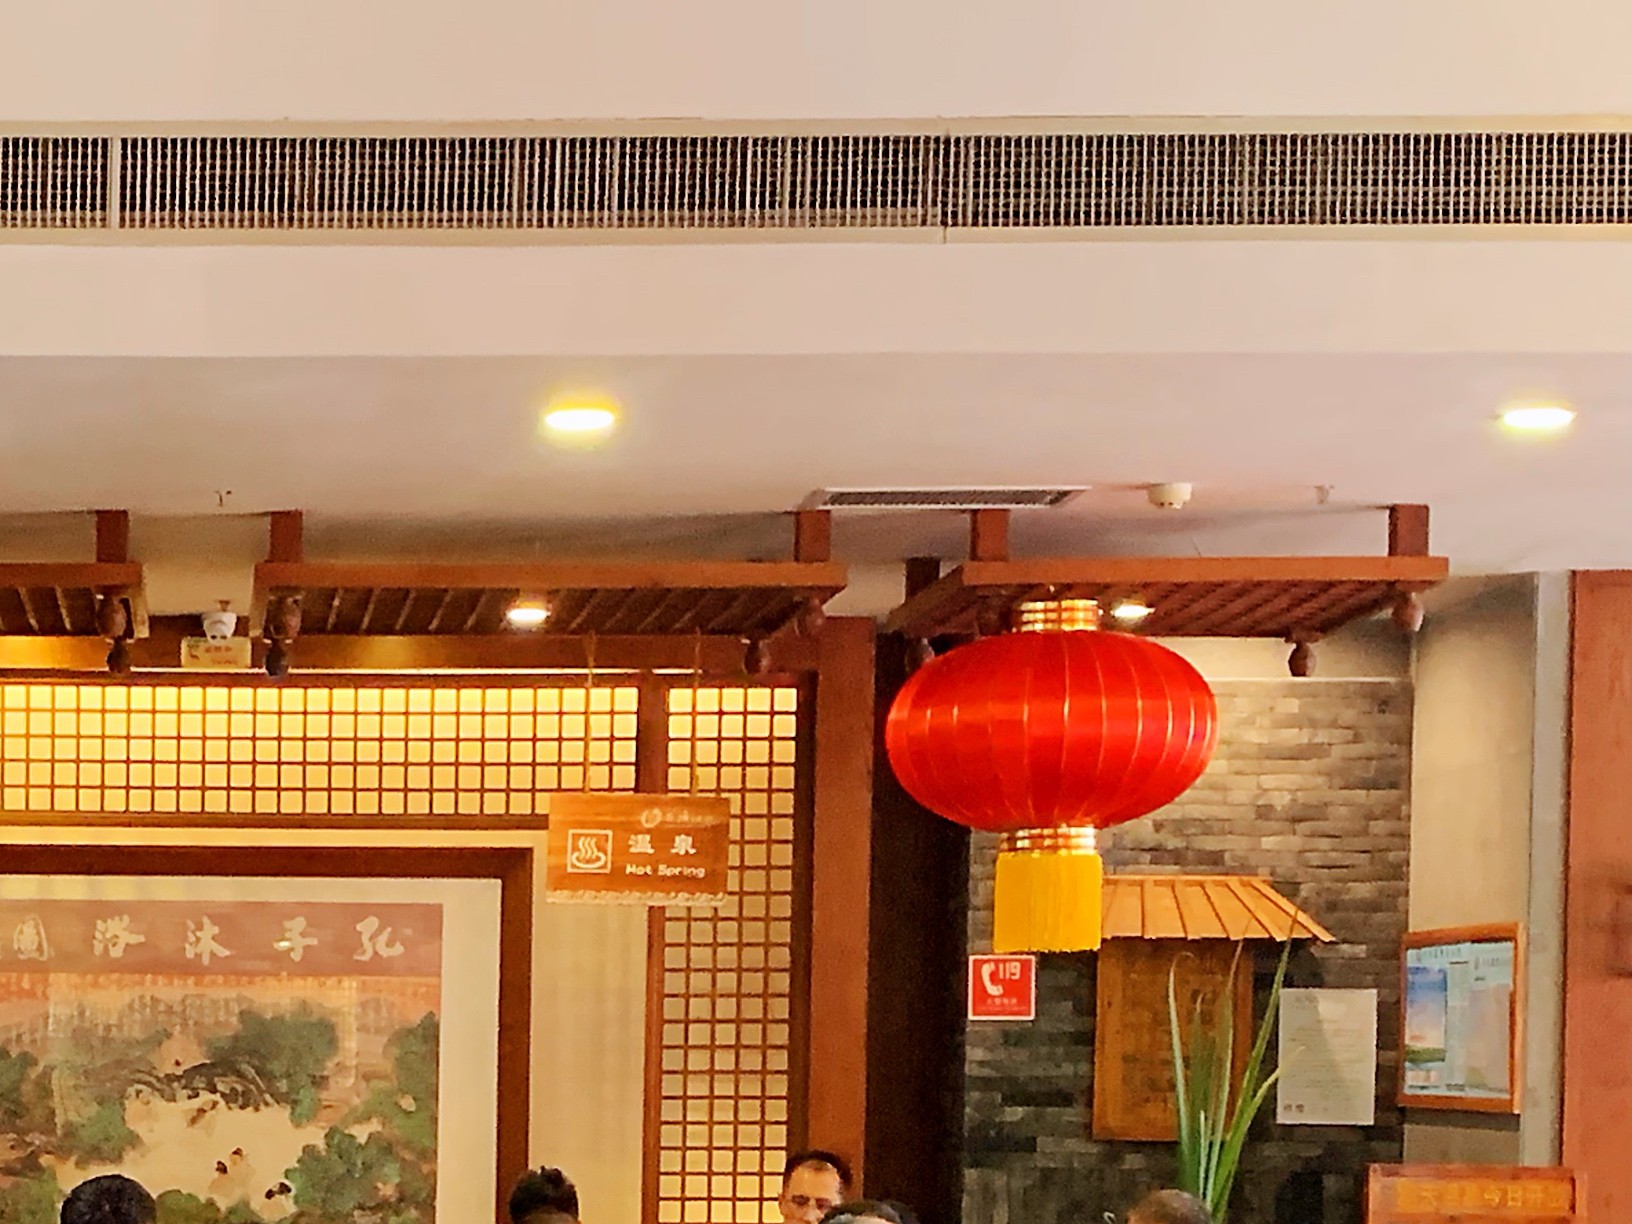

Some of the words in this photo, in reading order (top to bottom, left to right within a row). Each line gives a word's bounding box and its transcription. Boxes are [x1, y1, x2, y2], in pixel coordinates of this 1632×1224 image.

[628, 833, 696, 855] 温泉
[625, 863, 653, 875] Hot
[658, 865, 706, 878] Spring
[998, 961, 1021, 980] 119
